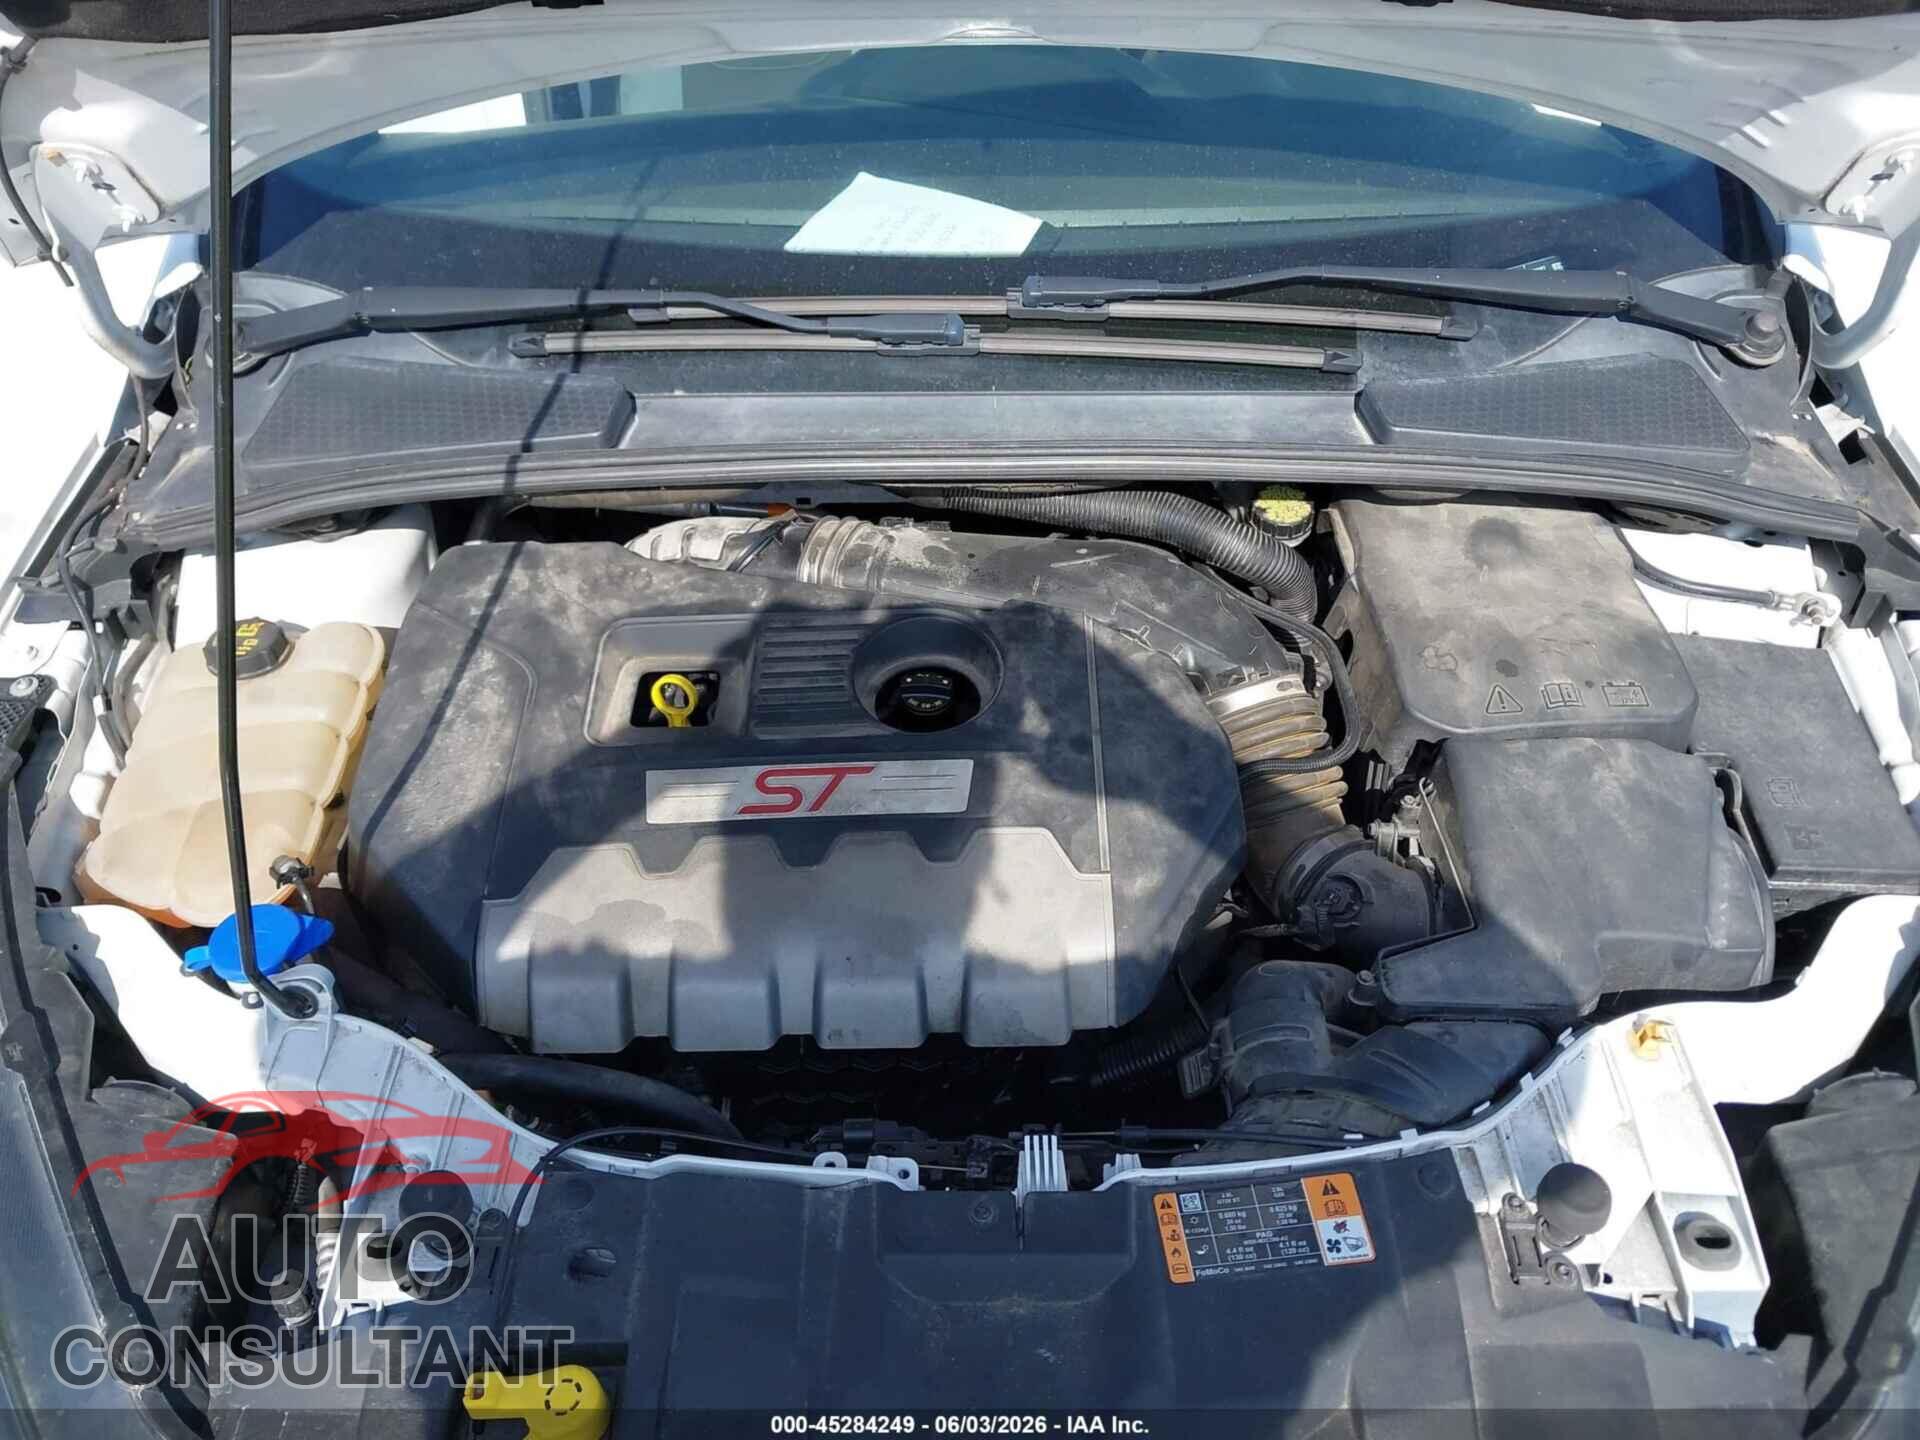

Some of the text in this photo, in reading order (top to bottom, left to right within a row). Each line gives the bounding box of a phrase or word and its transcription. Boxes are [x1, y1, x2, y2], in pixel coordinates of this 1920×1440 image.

[737, 765, 876, 815] ST
[1256, 1230, 1273, 1238] PAG
[1196, 1267, 1230, 1276] FoMoCo
